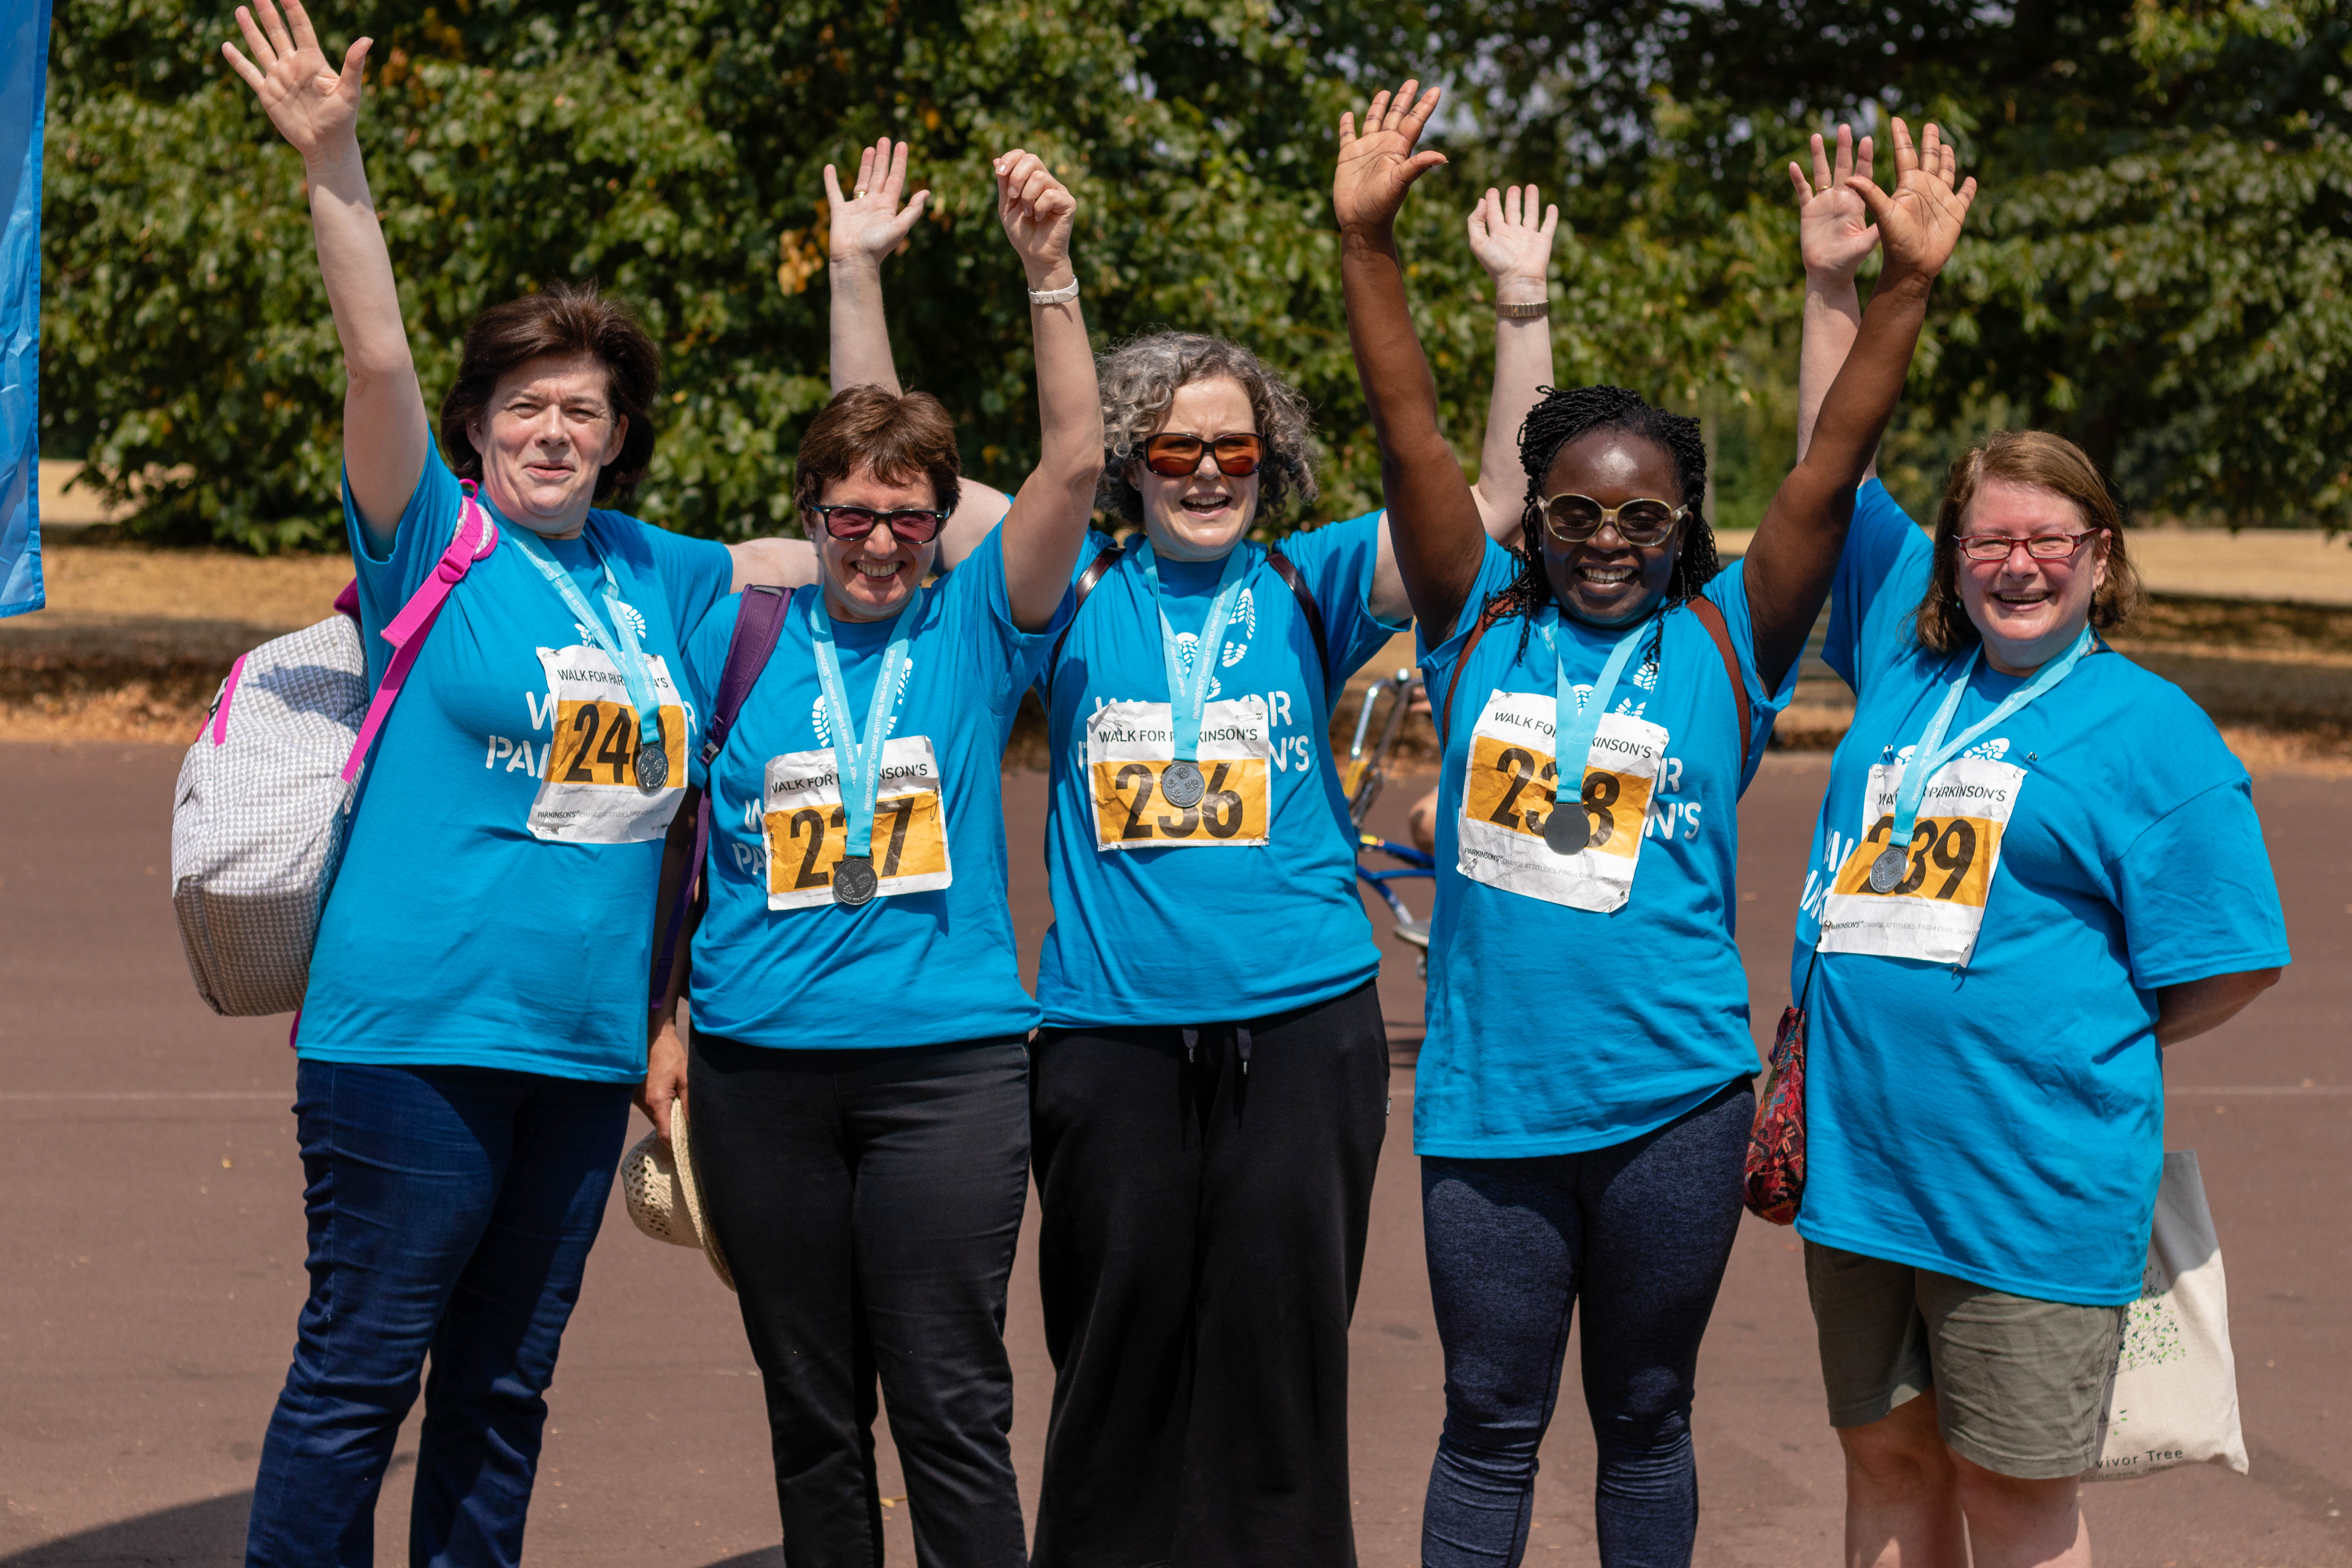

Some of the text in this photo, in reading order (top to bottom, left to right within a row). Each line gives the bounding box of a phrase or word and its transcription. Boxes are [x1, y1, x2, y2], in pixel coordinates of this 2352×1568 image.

[554, 577, 574, 600] CHANGE
[885, 656, 895, 670] JOIN
[557, 670, 588, 682] WALK
[589, 671, 608, 683] FOR
[878, 689, 887, 703] FIND
[1192, 679, 1205, 720] PARKINSON'S
[826, 679, 837, 701] CHANGE
[840, 728, 850, 743] FIND
[873, 703, 884, 733] ATTITUDES.
[1495, 712, 1533, 728] WALK
[1099, 729, 1136, 743] WALK
[1140, 730, 1165, 742] FOR
[870, 734, 879, 759] CHANGE
[808, 774, 833, 787] FOR
[864, 763, 875, 810] PARKINSON'S
[1929, 785, 2007, 802] PARKINSON'S
[1464, 847, 1500, 862] PARKINSON'S
[1502, 858, 1524, 868] CHANGE
[1857, 815, 1976, 900] 239
[2145, 1450, 2183, 1462] Tree
